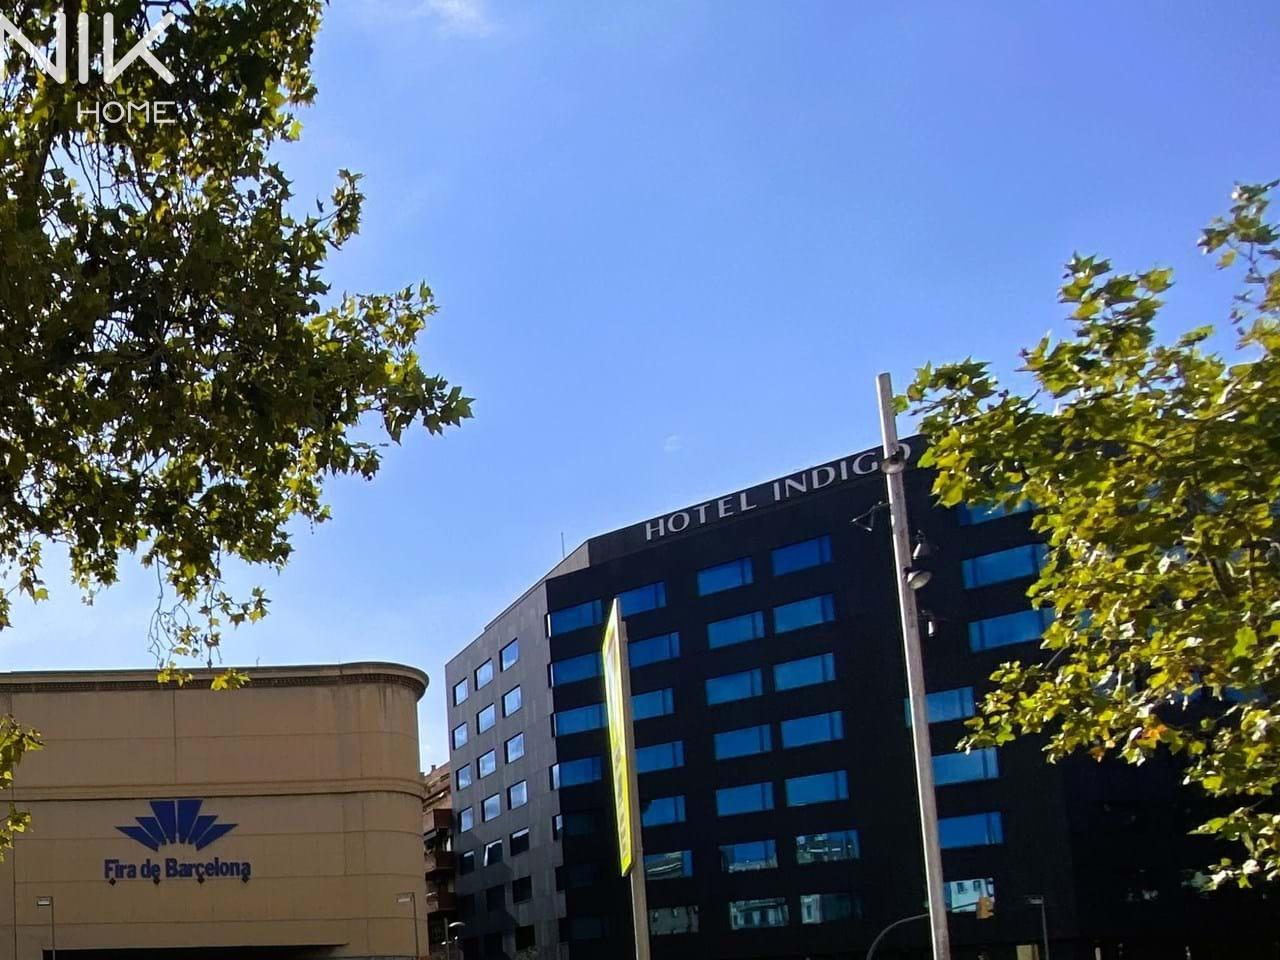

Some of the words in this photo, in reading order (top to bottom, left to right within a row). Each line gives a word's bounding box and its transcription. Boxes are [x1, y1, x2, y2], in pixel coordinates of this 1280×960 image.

[645, 491, 757, 541] HOTEL
[104, 859, 137, 879] Fira
[140, 858, 161, 879] de
[165, 857, 252, 879] Barcelona
